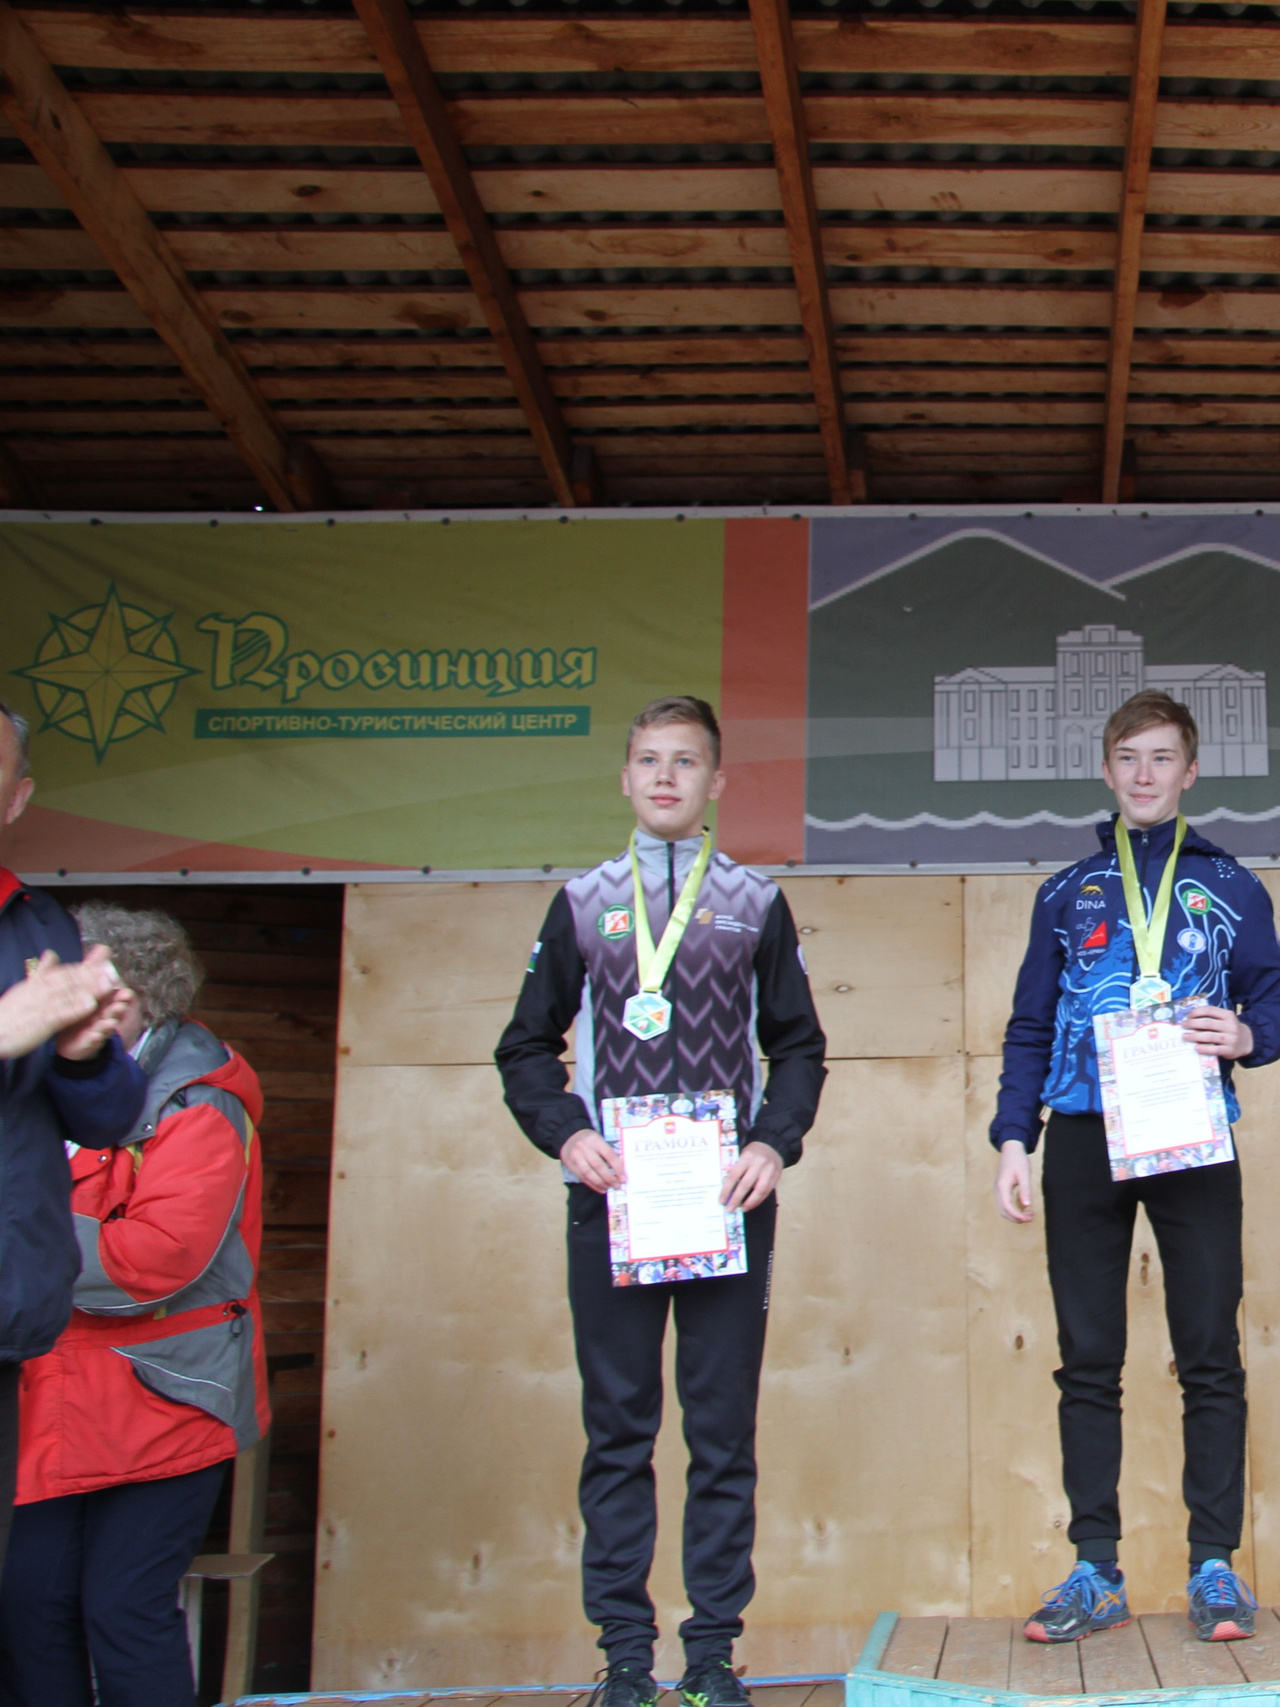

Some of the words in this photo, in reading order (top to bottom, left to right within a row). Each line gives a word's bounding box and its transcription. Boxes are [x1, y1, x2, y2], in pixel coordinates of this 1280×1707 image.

[195, 611, 597, 704] Провинция
[208, 712, 505, 732] СПОРТИВНО-ТУРИСТИЧЕСКИЙ
[511, 713, 578, 731] ЦЕНТР
[1076, 899, 1106, 910] DINA
[634, 1136, 708, 1153] ГРАМОТА
